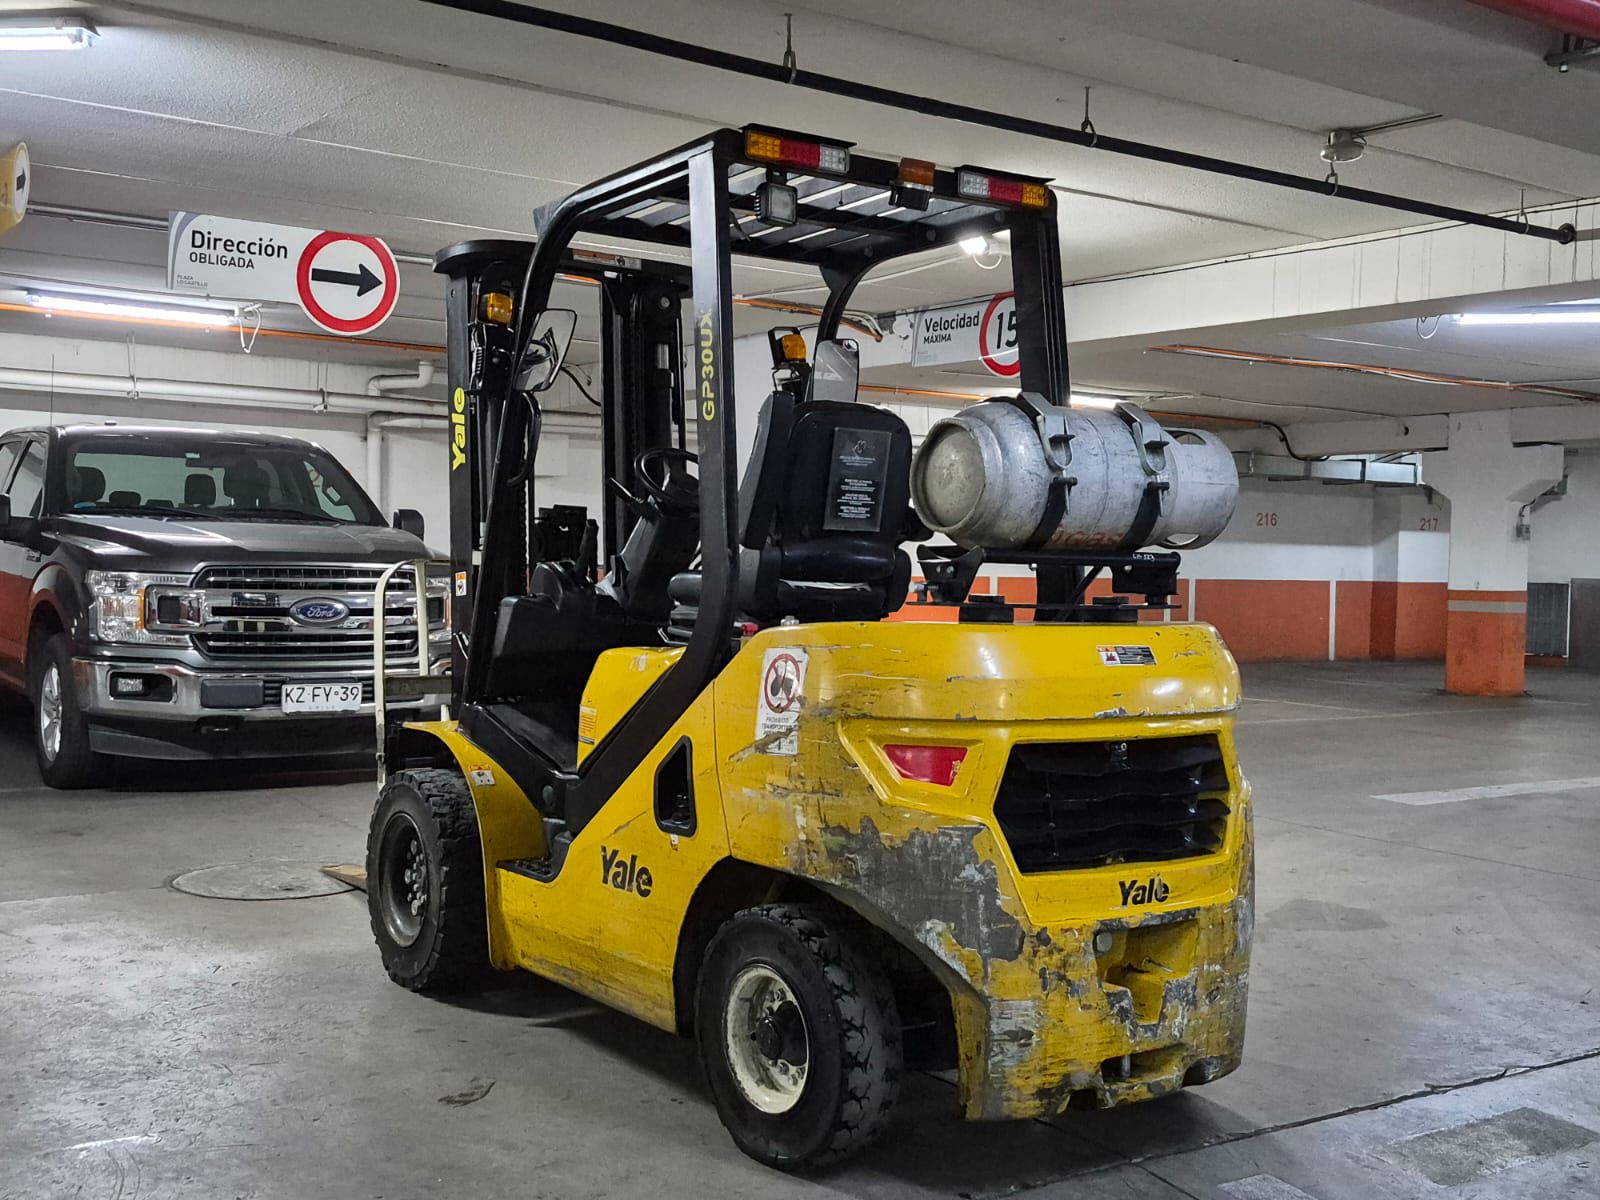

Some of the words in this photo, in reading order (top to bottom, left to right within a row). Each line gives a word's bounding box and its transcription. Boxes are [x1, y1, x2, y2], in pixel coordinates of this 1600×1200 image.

[191, 230, 288, 259] Dirección
[189, 252, 255, 269] OBLIGADA
[925, 311, 979, 333] Velocidad
[996, 311, 1018, 350] 15
[923, 333, 952, 344] MÁXIMA
[701, 312, 715, 421] GP30UX
[452, 387, 466, 471] Yale
[1256, 513, 1278, 527] 216
[1419, 518, 1439, 531] 217
[307, 605, 335, 617] Ford
[601, 845, 653, 898] Yale
[1119, 878, 1169, 906] Yale
